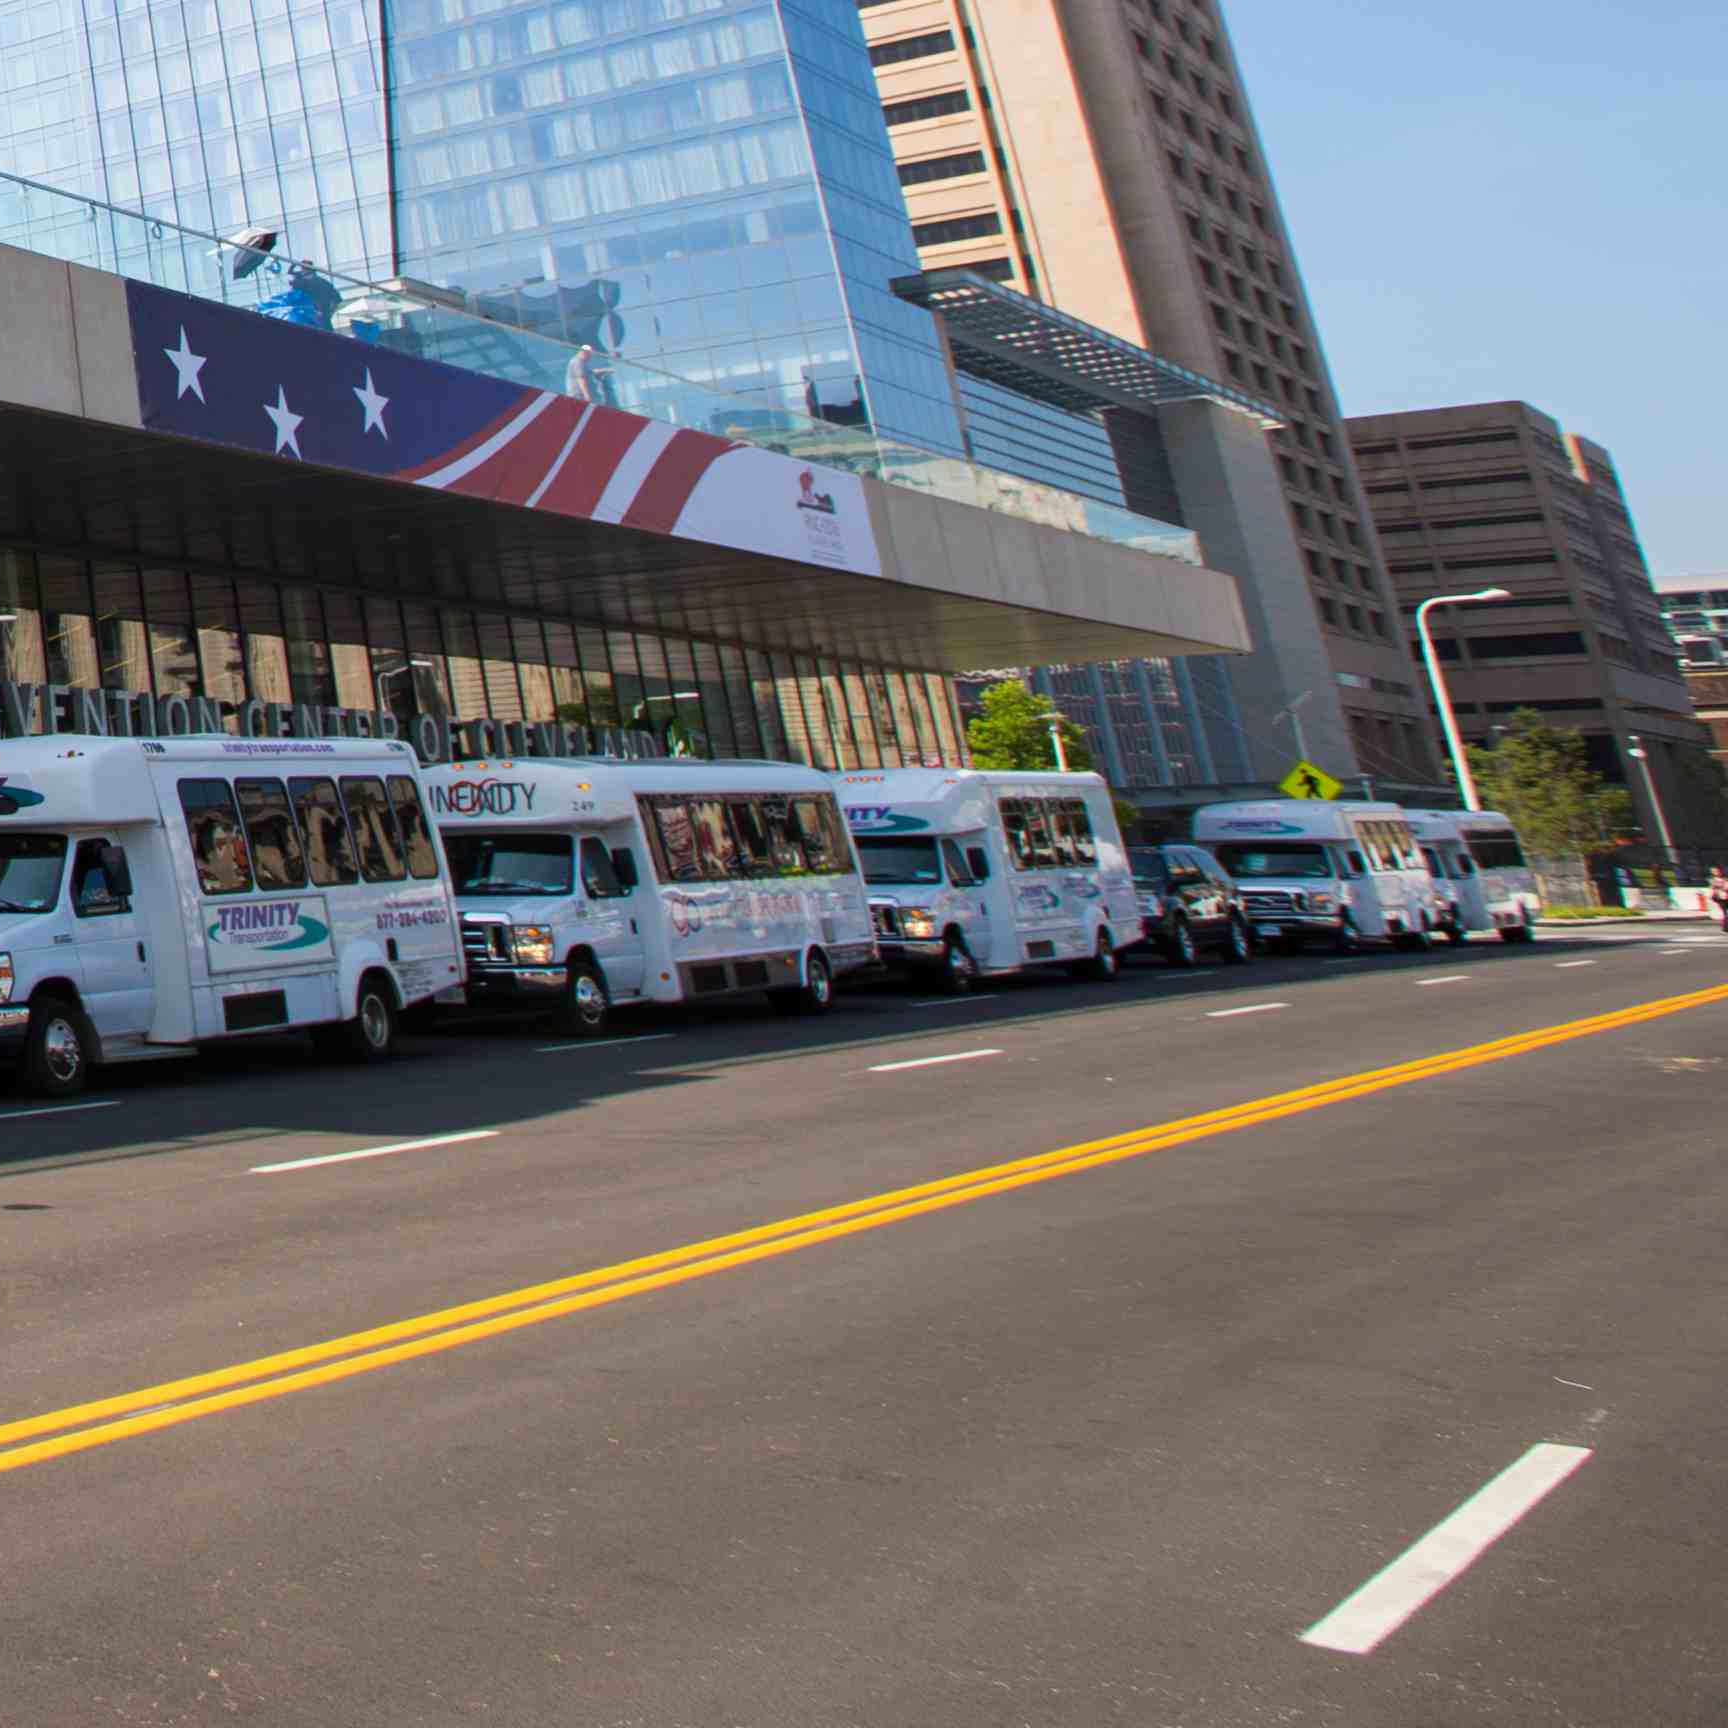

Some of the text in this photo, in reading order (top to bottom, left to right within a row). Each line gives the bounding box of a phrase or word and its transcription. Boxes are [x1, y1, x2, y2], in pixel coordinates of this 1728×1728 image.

[243, 700, 399, 739] CENTER
[415, 713, 459, 761] OF
[471, 718, 657, 760] CLEVELAND
[570, 800, 594, 812] 249
[217, 902, 302, 931] TRINITY
[228, 928, 289, 945] Transportation
